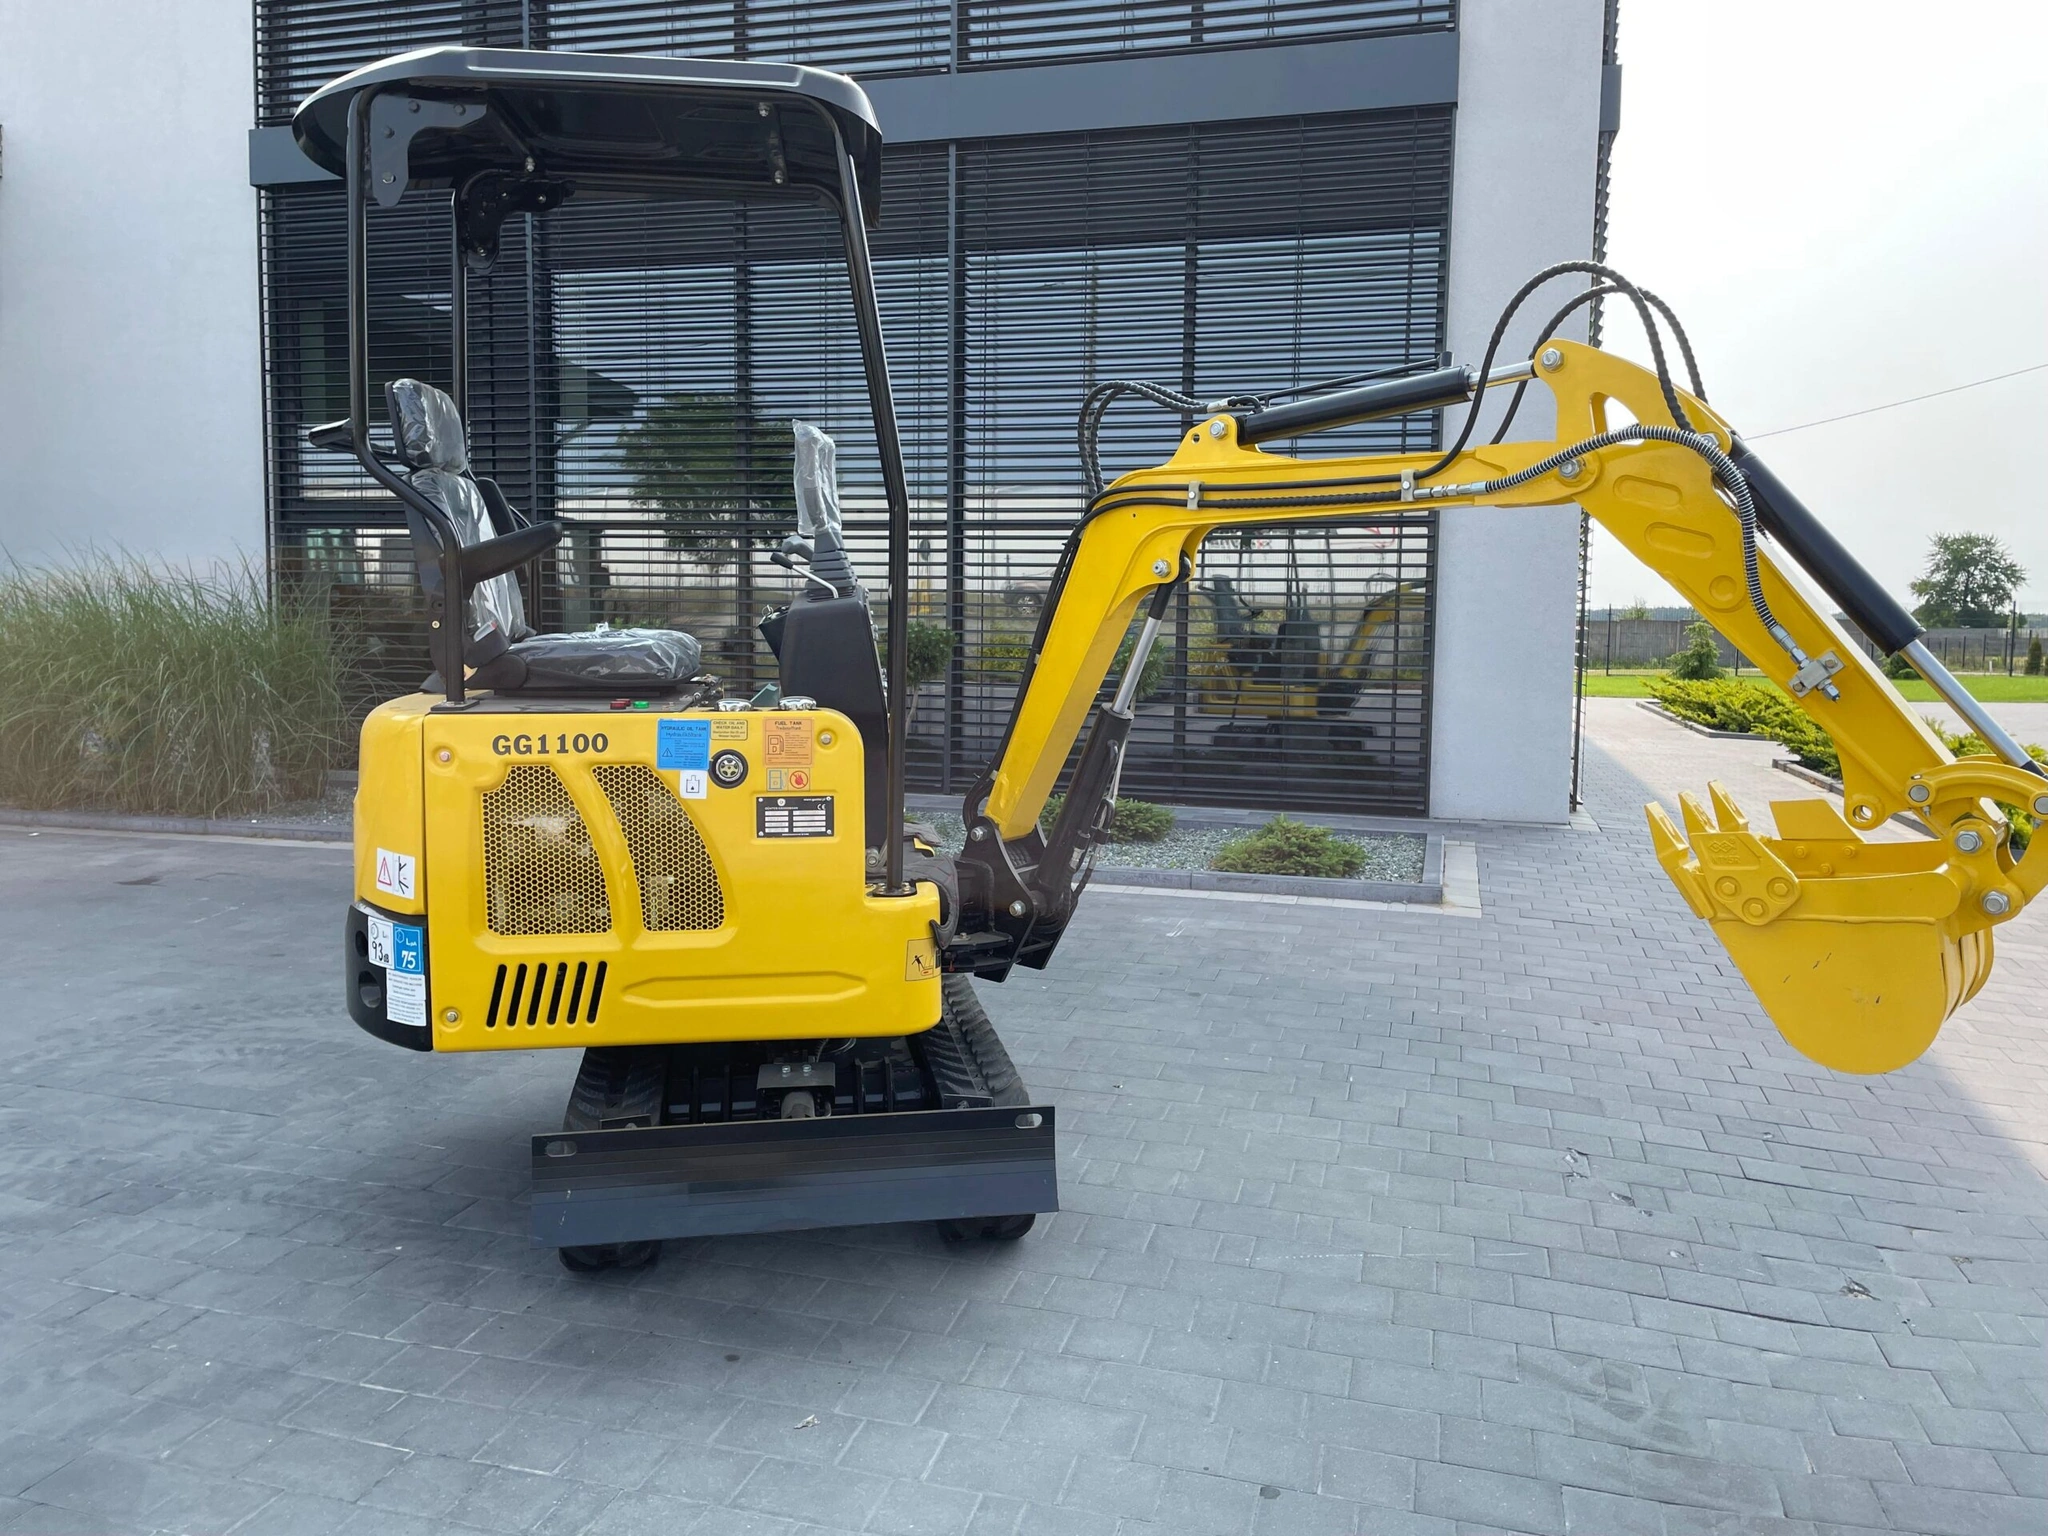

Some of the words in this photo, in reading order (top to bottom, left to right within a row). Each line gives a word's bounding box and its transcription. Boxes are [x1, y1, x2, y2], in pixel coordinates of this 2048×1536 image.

[492, 733, 608, 755] GG1100
[372, 941, 383, 961] 93
[401, 950, 416, 969] 75
